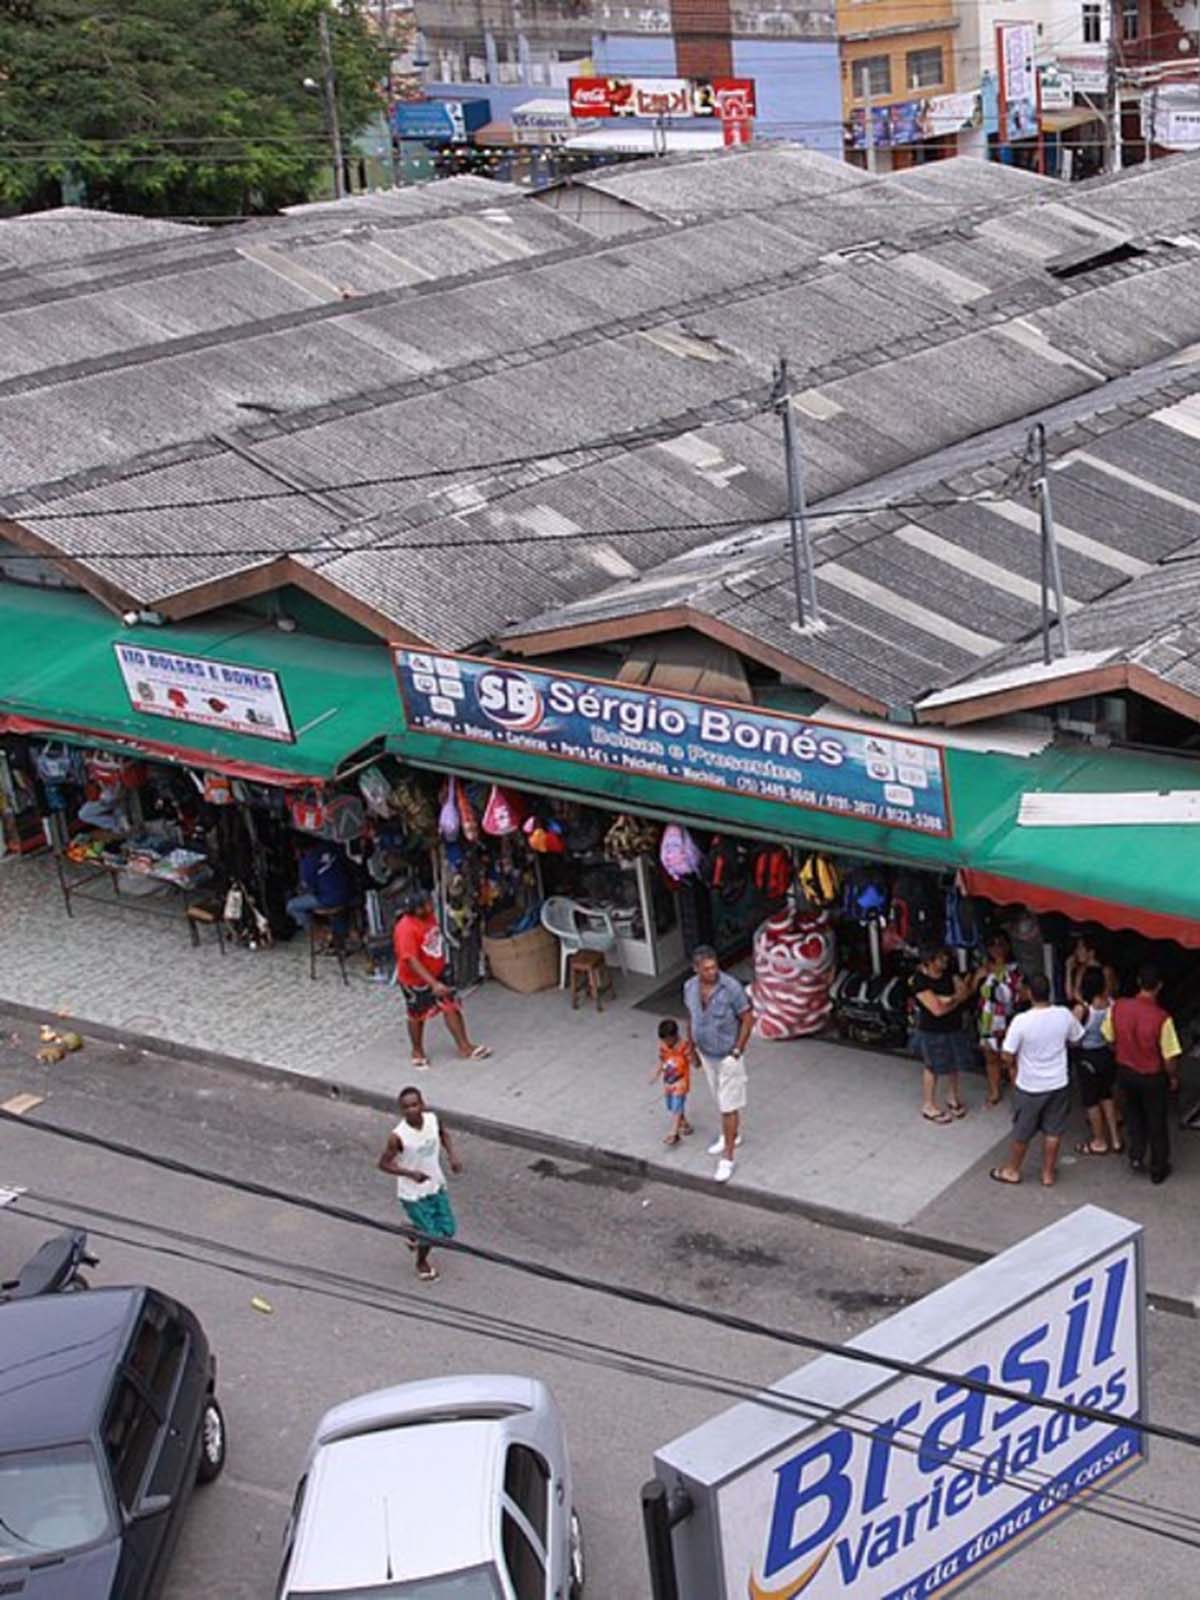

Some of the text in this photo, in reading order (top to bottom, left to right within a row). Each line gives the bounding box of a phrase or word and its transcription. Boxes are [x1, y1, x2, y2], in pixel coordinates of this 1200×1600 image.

[478, 675, 534, 716] SB
[550, 681, 844, 765] Sérgio Bonés
[764, 1258, 1128, 1578] Brasil
[836, 1368, 1127, 1586] Variedades
[924, 1561, 959, 1592] da
[966, 1509, 1032, 1563] dona
[1038, 1481, 1069, 1514] de
[1074, 1440, 1131, 1487] casa
